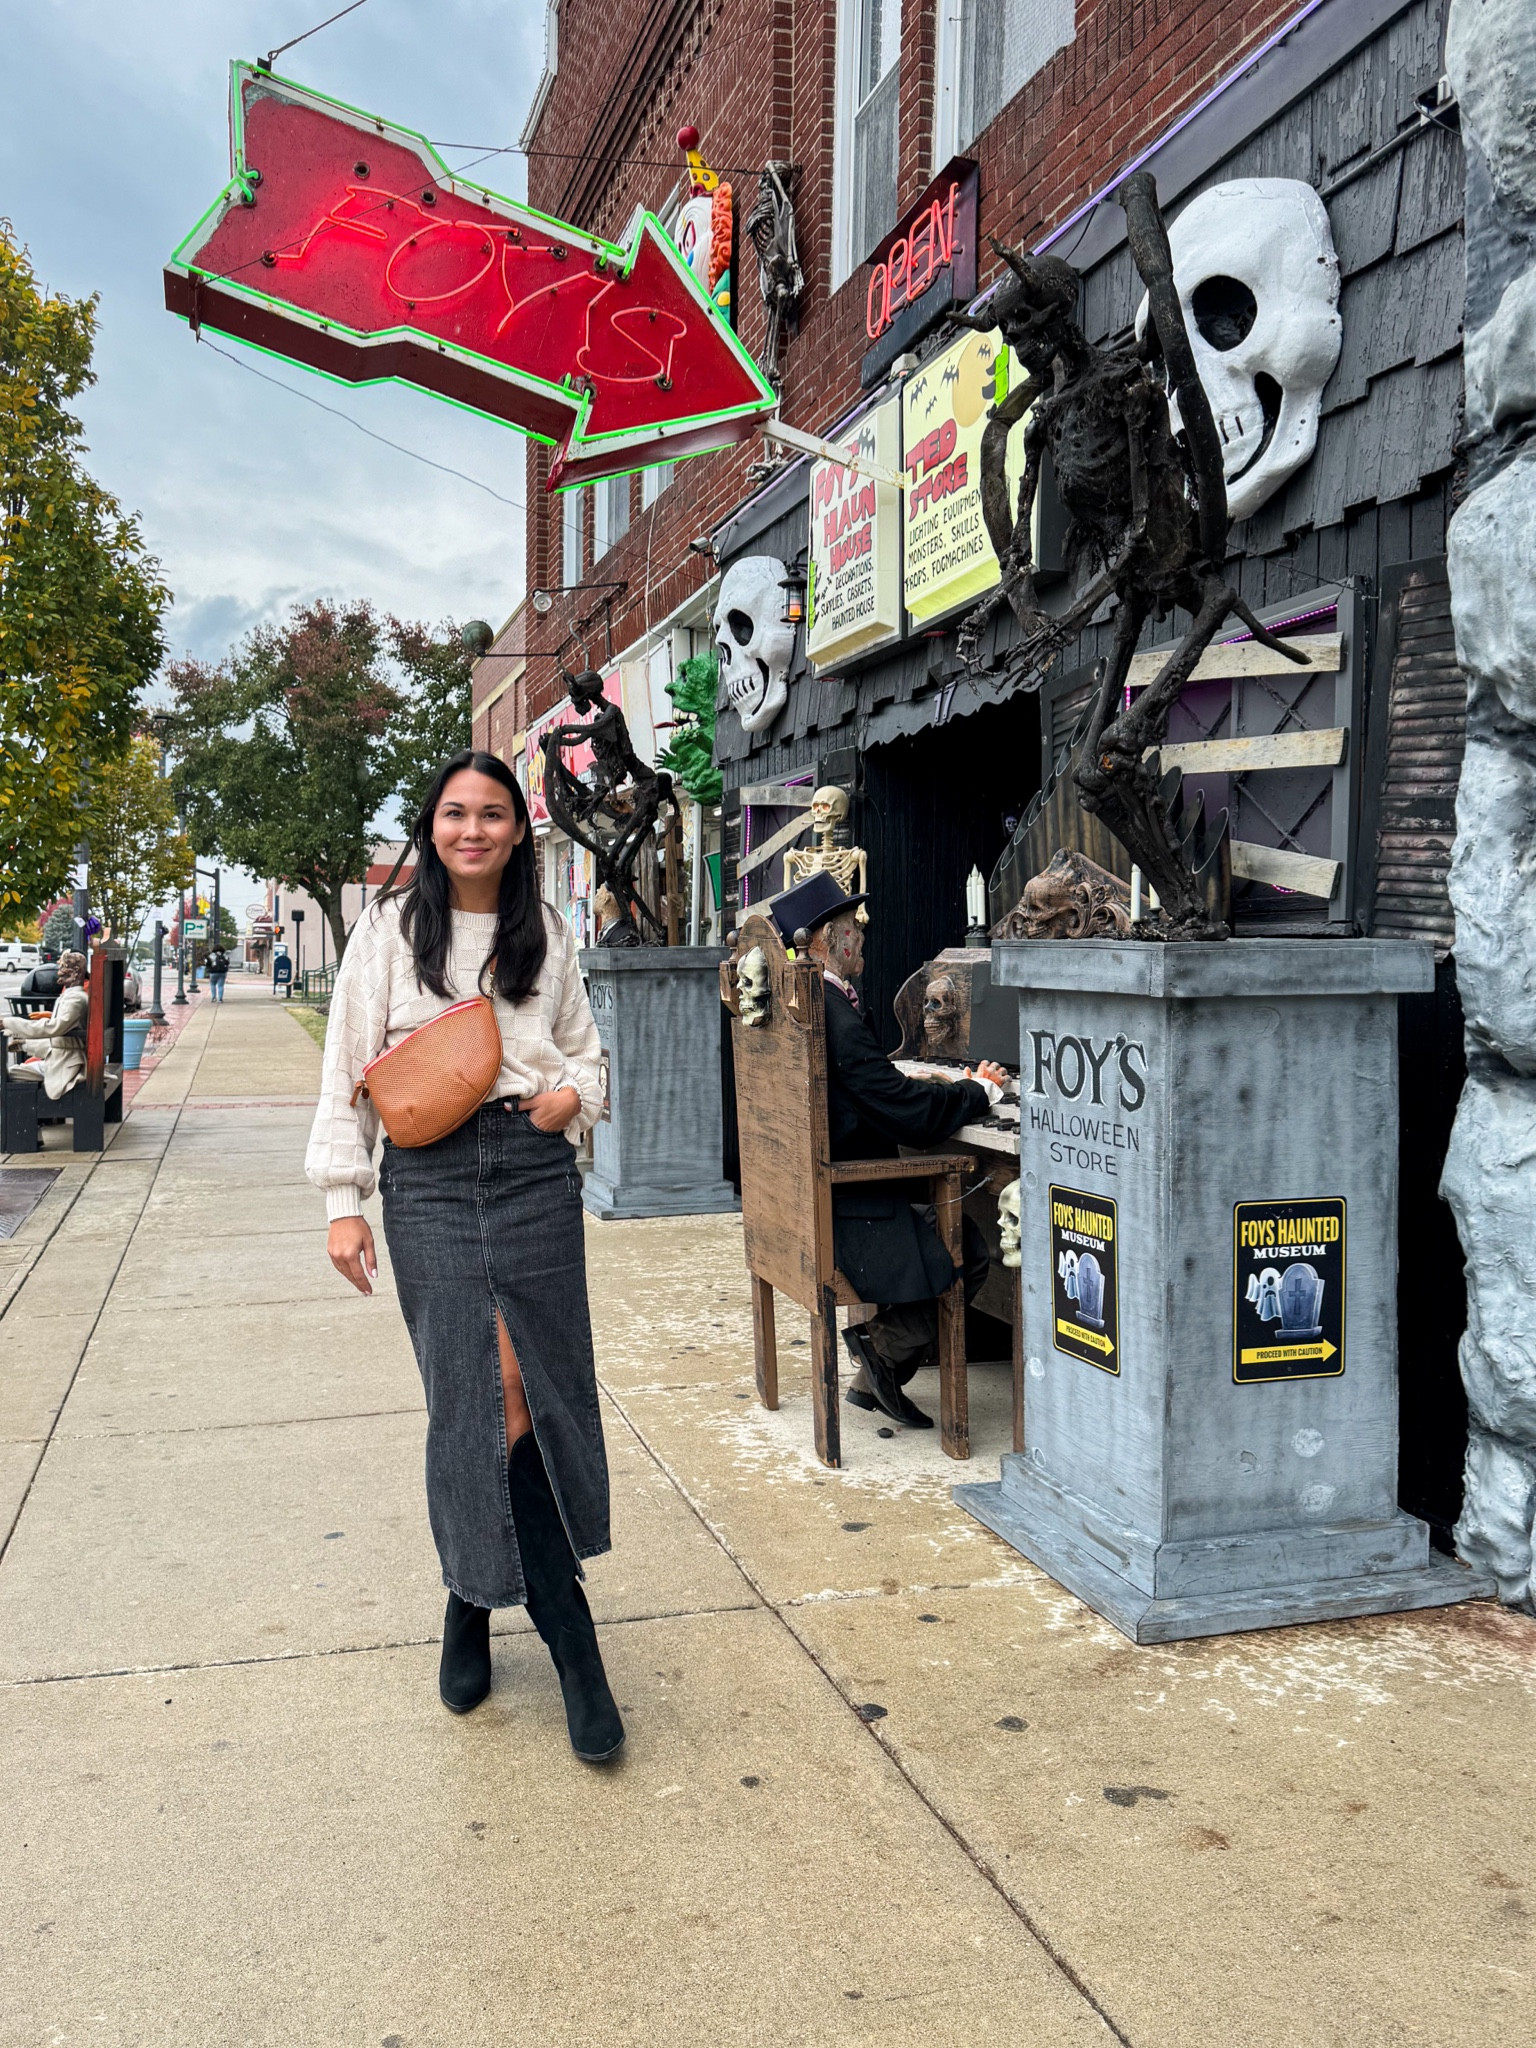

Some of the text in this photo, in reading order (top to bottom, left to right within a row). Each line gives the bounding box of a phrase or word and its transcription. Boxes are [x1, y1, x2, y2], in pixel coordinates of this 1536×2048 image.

[866, 182, 960, 339] OPEN
[906, 417, 958, 484] TED
[908, 451, 969, 523] STORE
[823, 479, 877, 548] HAUN
[909, 488, 981, 547] LIGHTING EQUIPMEN
[829, 521, 873, 576] HOUSE
[908, 512, 980, 569] MONSTERS, SKULLS
[931, 533, 984, 579] FOGMACHINES
[831, 594, 875, 631] HAUNTED HOUSE
[185, 922, 196, 935] P
[1026, 1029, 1149, 1113] FOY'S
[1030, 1106, 1140, 1152] HALLOWEEN
[1050, 1141, 1118, 1176] STORE
[1053, 1201, 1114, 1243] FOYS HAUNTED
[1060, 1228, 1106, 1252] MUSEUM
[1241, 1216, 1340, 1247] FOYS HAUNTED
[1253, 1244, 1327, 1260] MUSEUM
[1256, 1347, 1323, 1360] PROCEED WITH CAUTION
